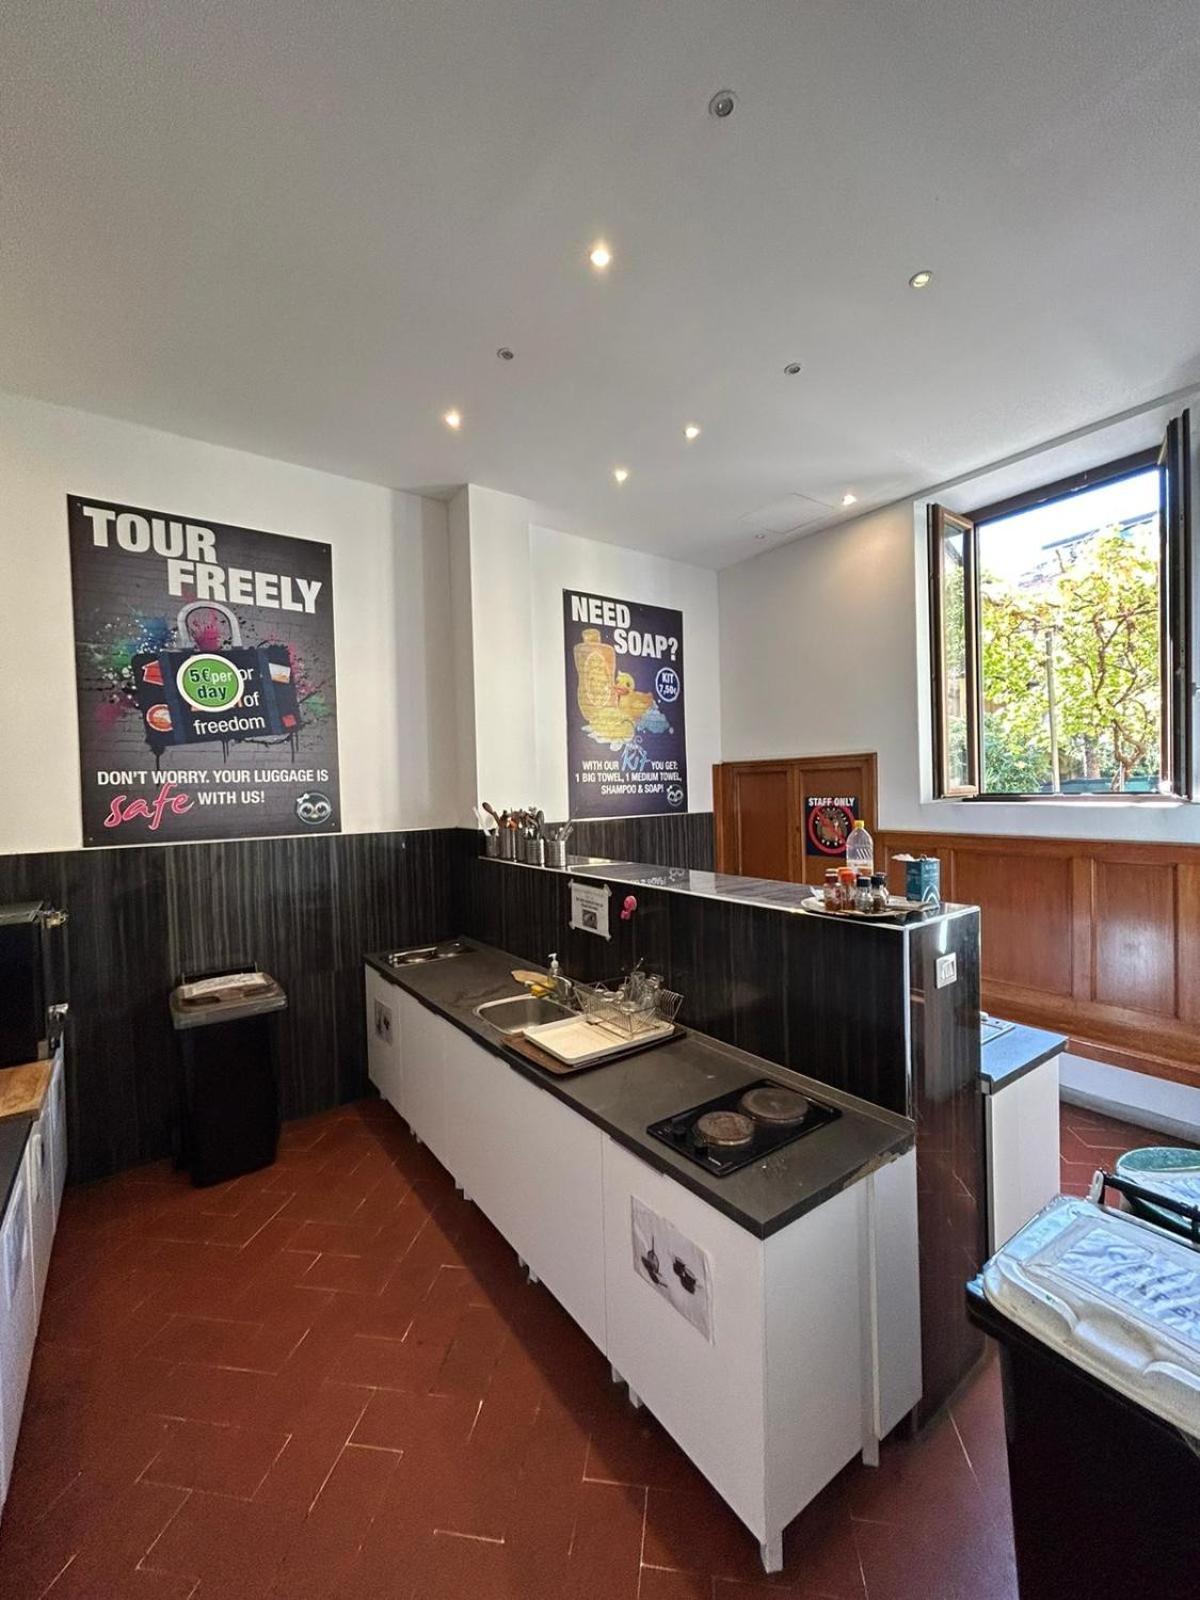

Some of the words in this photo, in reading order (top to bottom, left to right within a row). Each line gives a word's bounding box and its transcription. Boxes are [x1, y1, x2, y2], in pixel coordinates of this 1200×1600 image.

[83, 505, 217, 563] TOUR
[167, 558, 322, 614] FREELY
[571, 595, 631, 629] NEED
[613, 628, 679, 661] SOAP?
[661, 672, 674, 684] KIT
[197, 685, 227, 700] day
[243, 691, 260, 707] of
[193, 715, 266, 735] freedom
[582, 760, 602, 770] WITH
[603, 760, 620, 770] OUR
[651, 760, 664, 770] YOU
[97, 770, 147, 785] DON'T
[151, 770, 210, 785] WORRY.
[213, 769, 250, 784] YOUR
[254, 769, 314, 783] LUGGAGE
[316, 768, 329, 782] IS
[575, 773, 580, 782] 1
[582, 772, 596, 782] BIG
[626, 772, 630, 782] 1
[631, 772, 659, 782] MEDIUM
[601, 784, 637, 795] SHAMPOO
[638, 784, 643, 794] &
[103, 782, 195, 830] safe
[197, 791, 236, 805] WITH
[241, 790, 265, 804] US!
[808, 797, 832, 807] STAFF
[834, 797, 855, 807] ONLY
